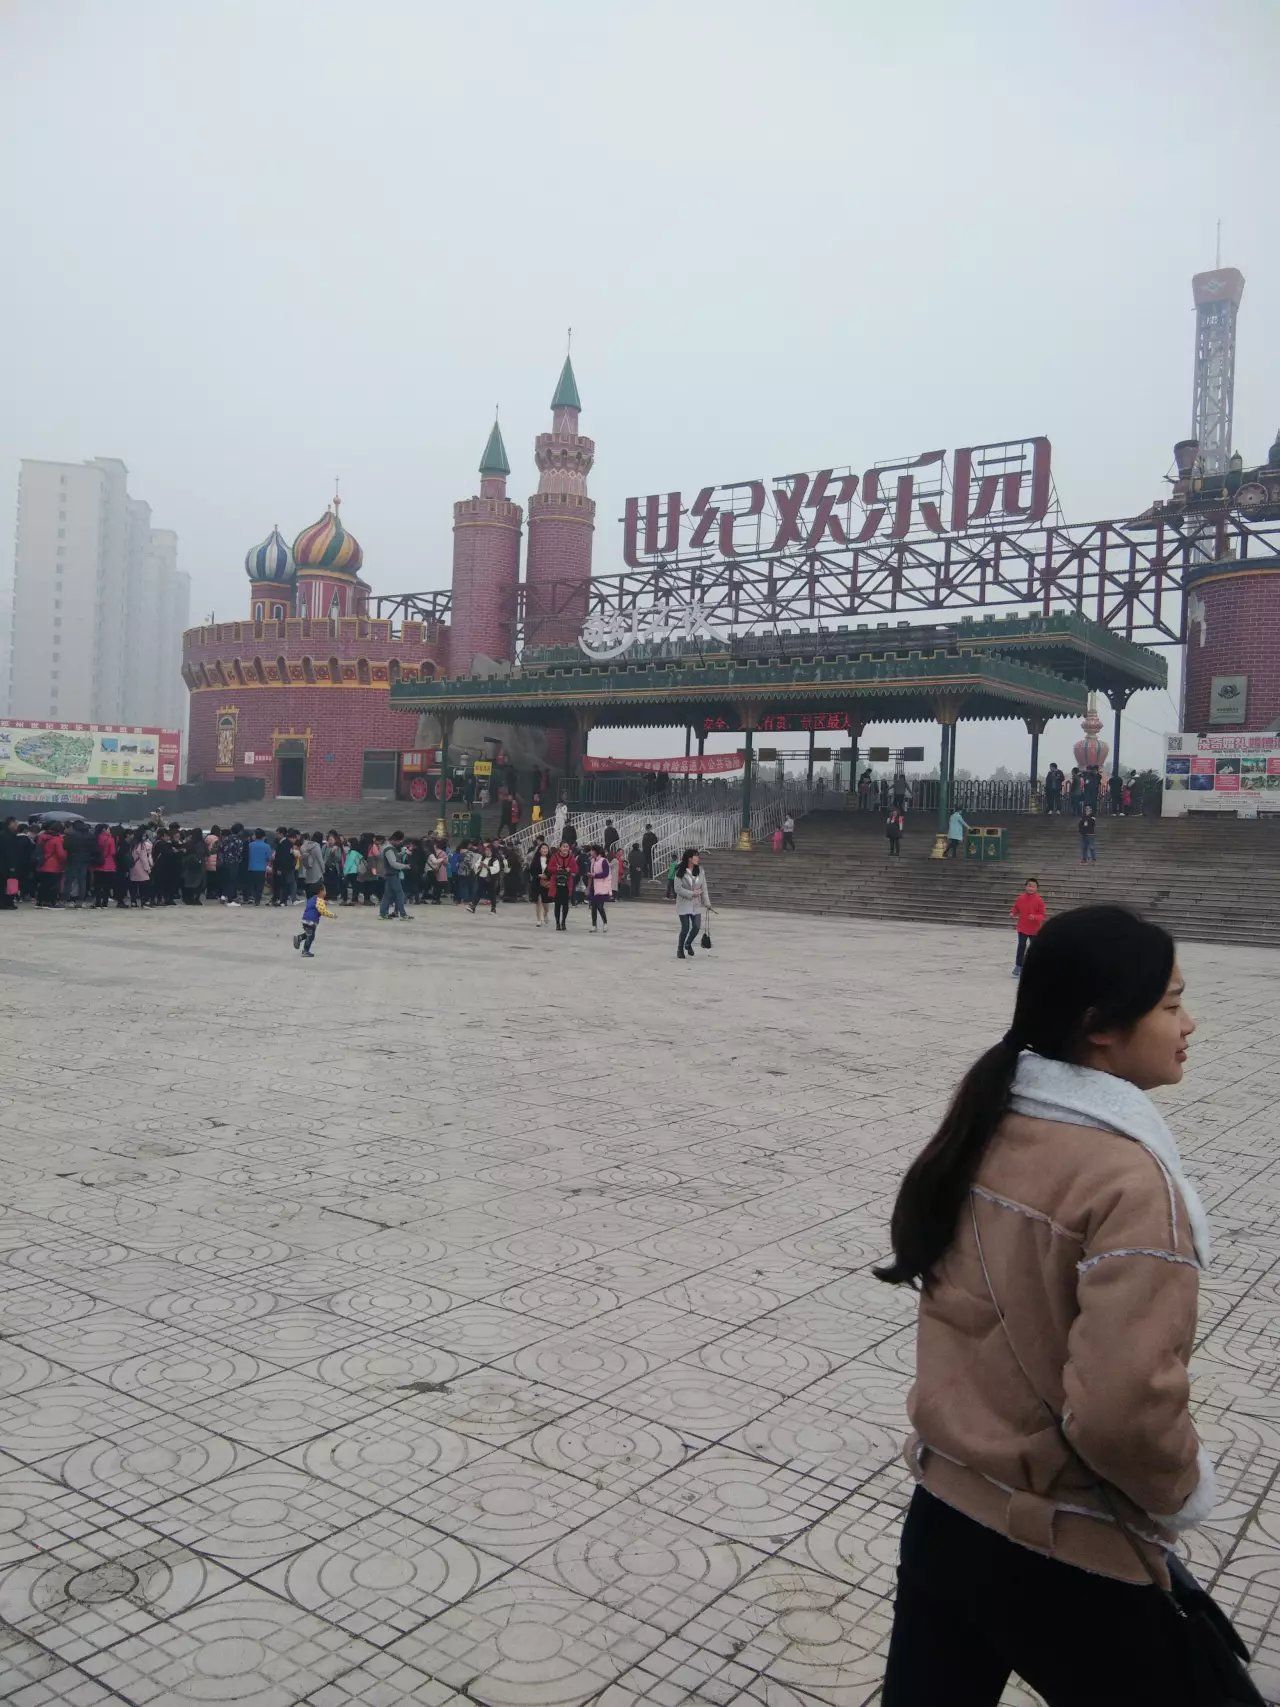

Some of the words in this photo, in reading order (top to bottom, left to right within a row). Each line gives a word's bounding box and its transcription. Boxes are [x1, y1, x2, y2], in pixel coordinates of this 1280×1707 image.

[618, 436, 1052, 568] 世纪欢乐园
